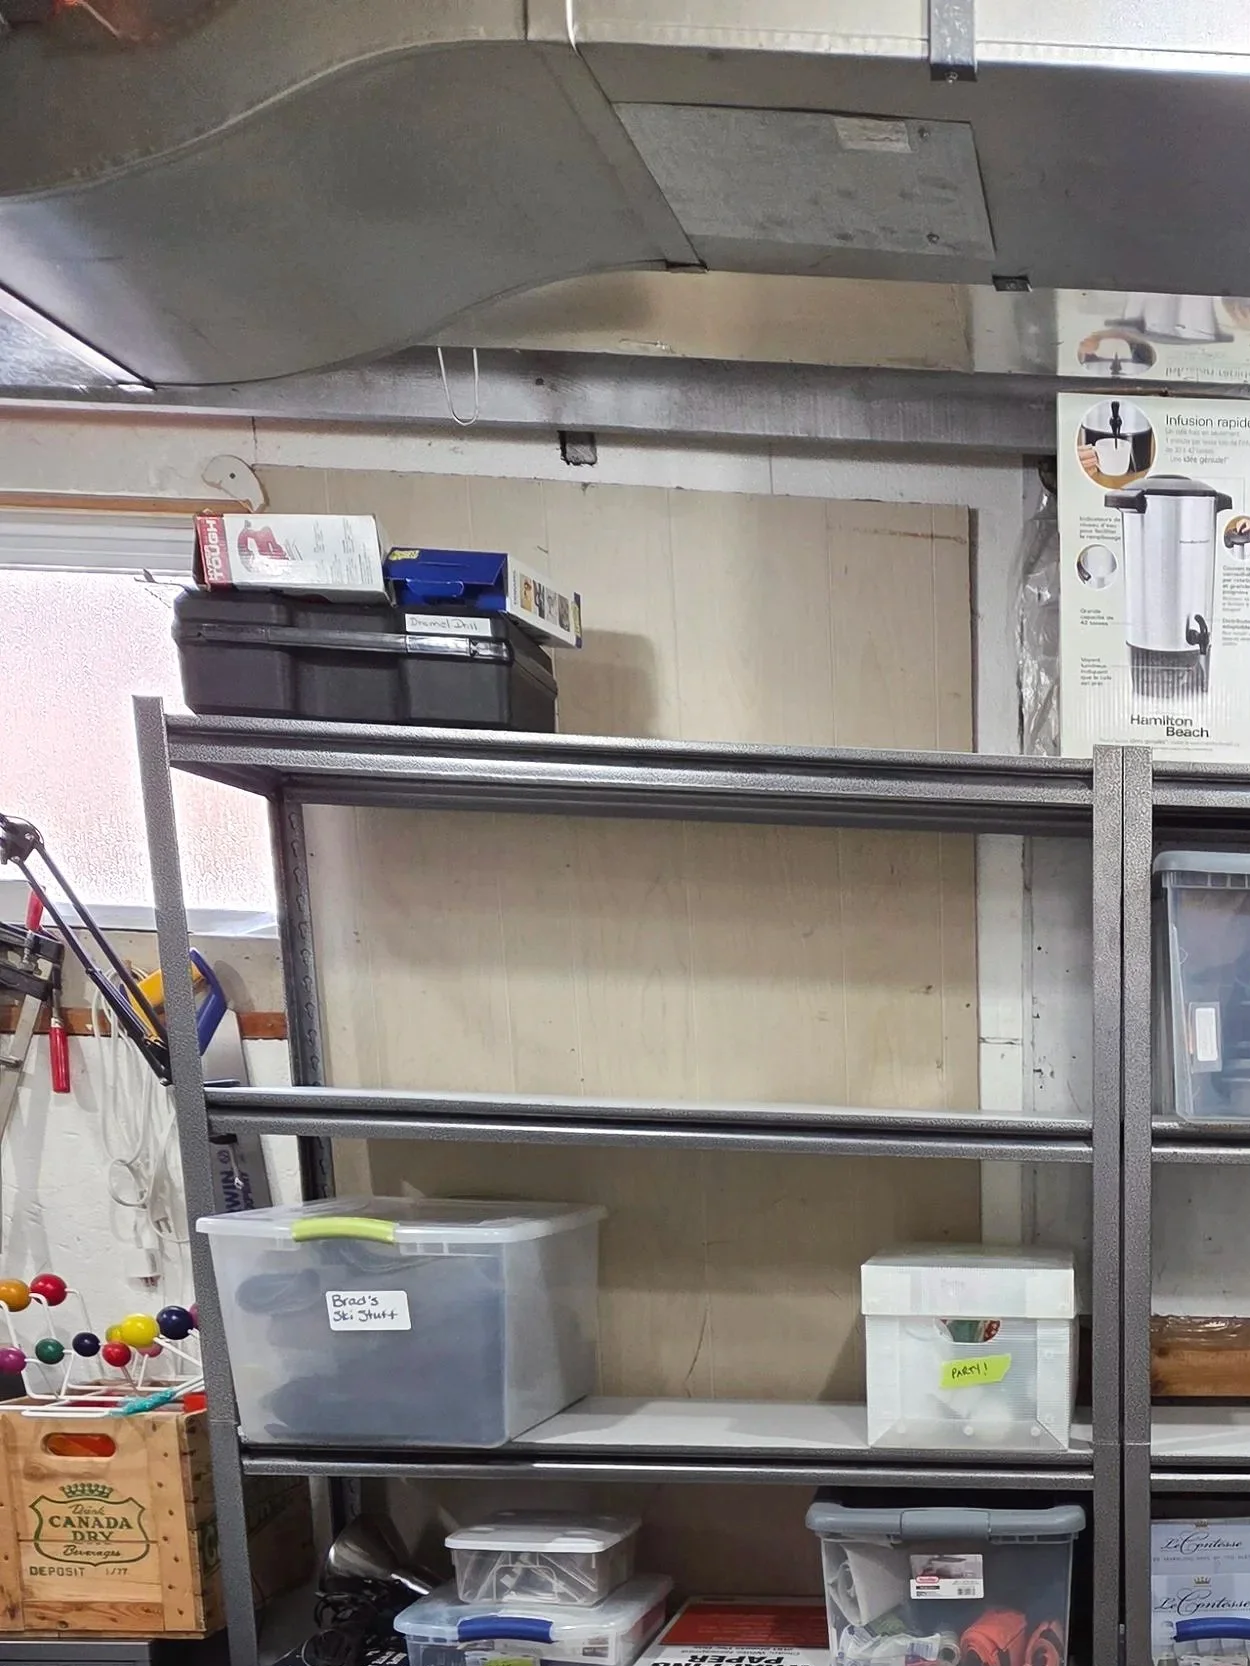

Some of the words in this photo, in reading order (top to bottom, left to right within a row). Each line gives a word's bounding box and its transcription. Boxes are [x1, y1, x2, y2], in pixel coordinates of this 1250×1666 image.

[1166, 414, 1213, 427] Infusion
[452, 618, 478, 632] Drill
[1130, 714, 1193, 727] Hamilton
[1166, 727, 1209, 738] Beach
[331, 1294, 379, 1308] Brad's
[48, 1515, 134, 1529] CANADA
[71, 1530, 115, 1544] DRY
[62, 1544, 122, 1560] Beverages
[29, 1566, 86, 1577] DEPOSIT
[688, 1654, 785, 1664] PAPER
